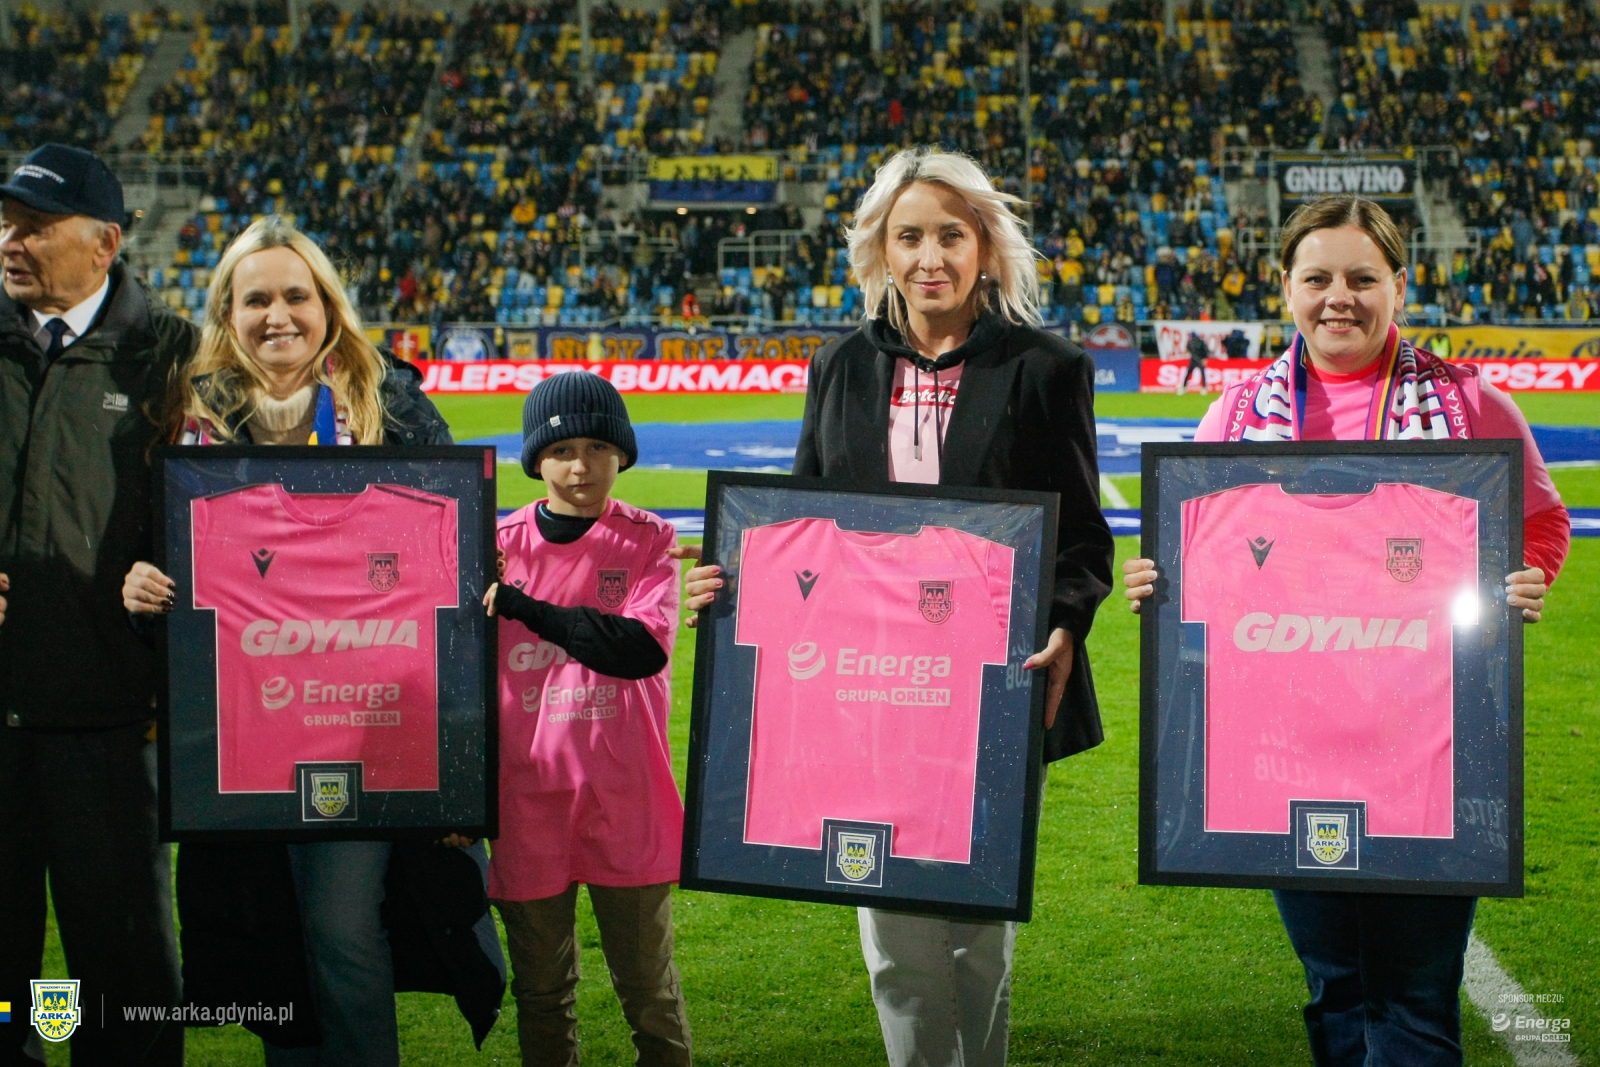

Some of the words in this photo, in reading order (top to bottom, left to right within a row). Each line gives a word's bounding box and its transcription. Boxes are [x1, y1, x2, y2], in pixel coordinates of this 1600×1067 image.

[1285, 164, 1405, 194] GNIEWINO
[610, 364, 809, 391] BUKMAC
[240, 619, 418, 657] GDYNIA
[1233, 612, 1428, 652] GDYNIA
[836, 648, 951, 685] Energa
[303, 680, 400, 708] Energa
[547, 684, 617, 706] Energa
[836, 689, 889, 703] GRUPA
[892, 689, 950, 705] ORLEN
[304, 714, 349, 726] GRUPA
[352, 712, 399, 725] ORLEN
[548, 712, 583, 723] GRUPA
[584, 706, 617, 720] ORLEN
